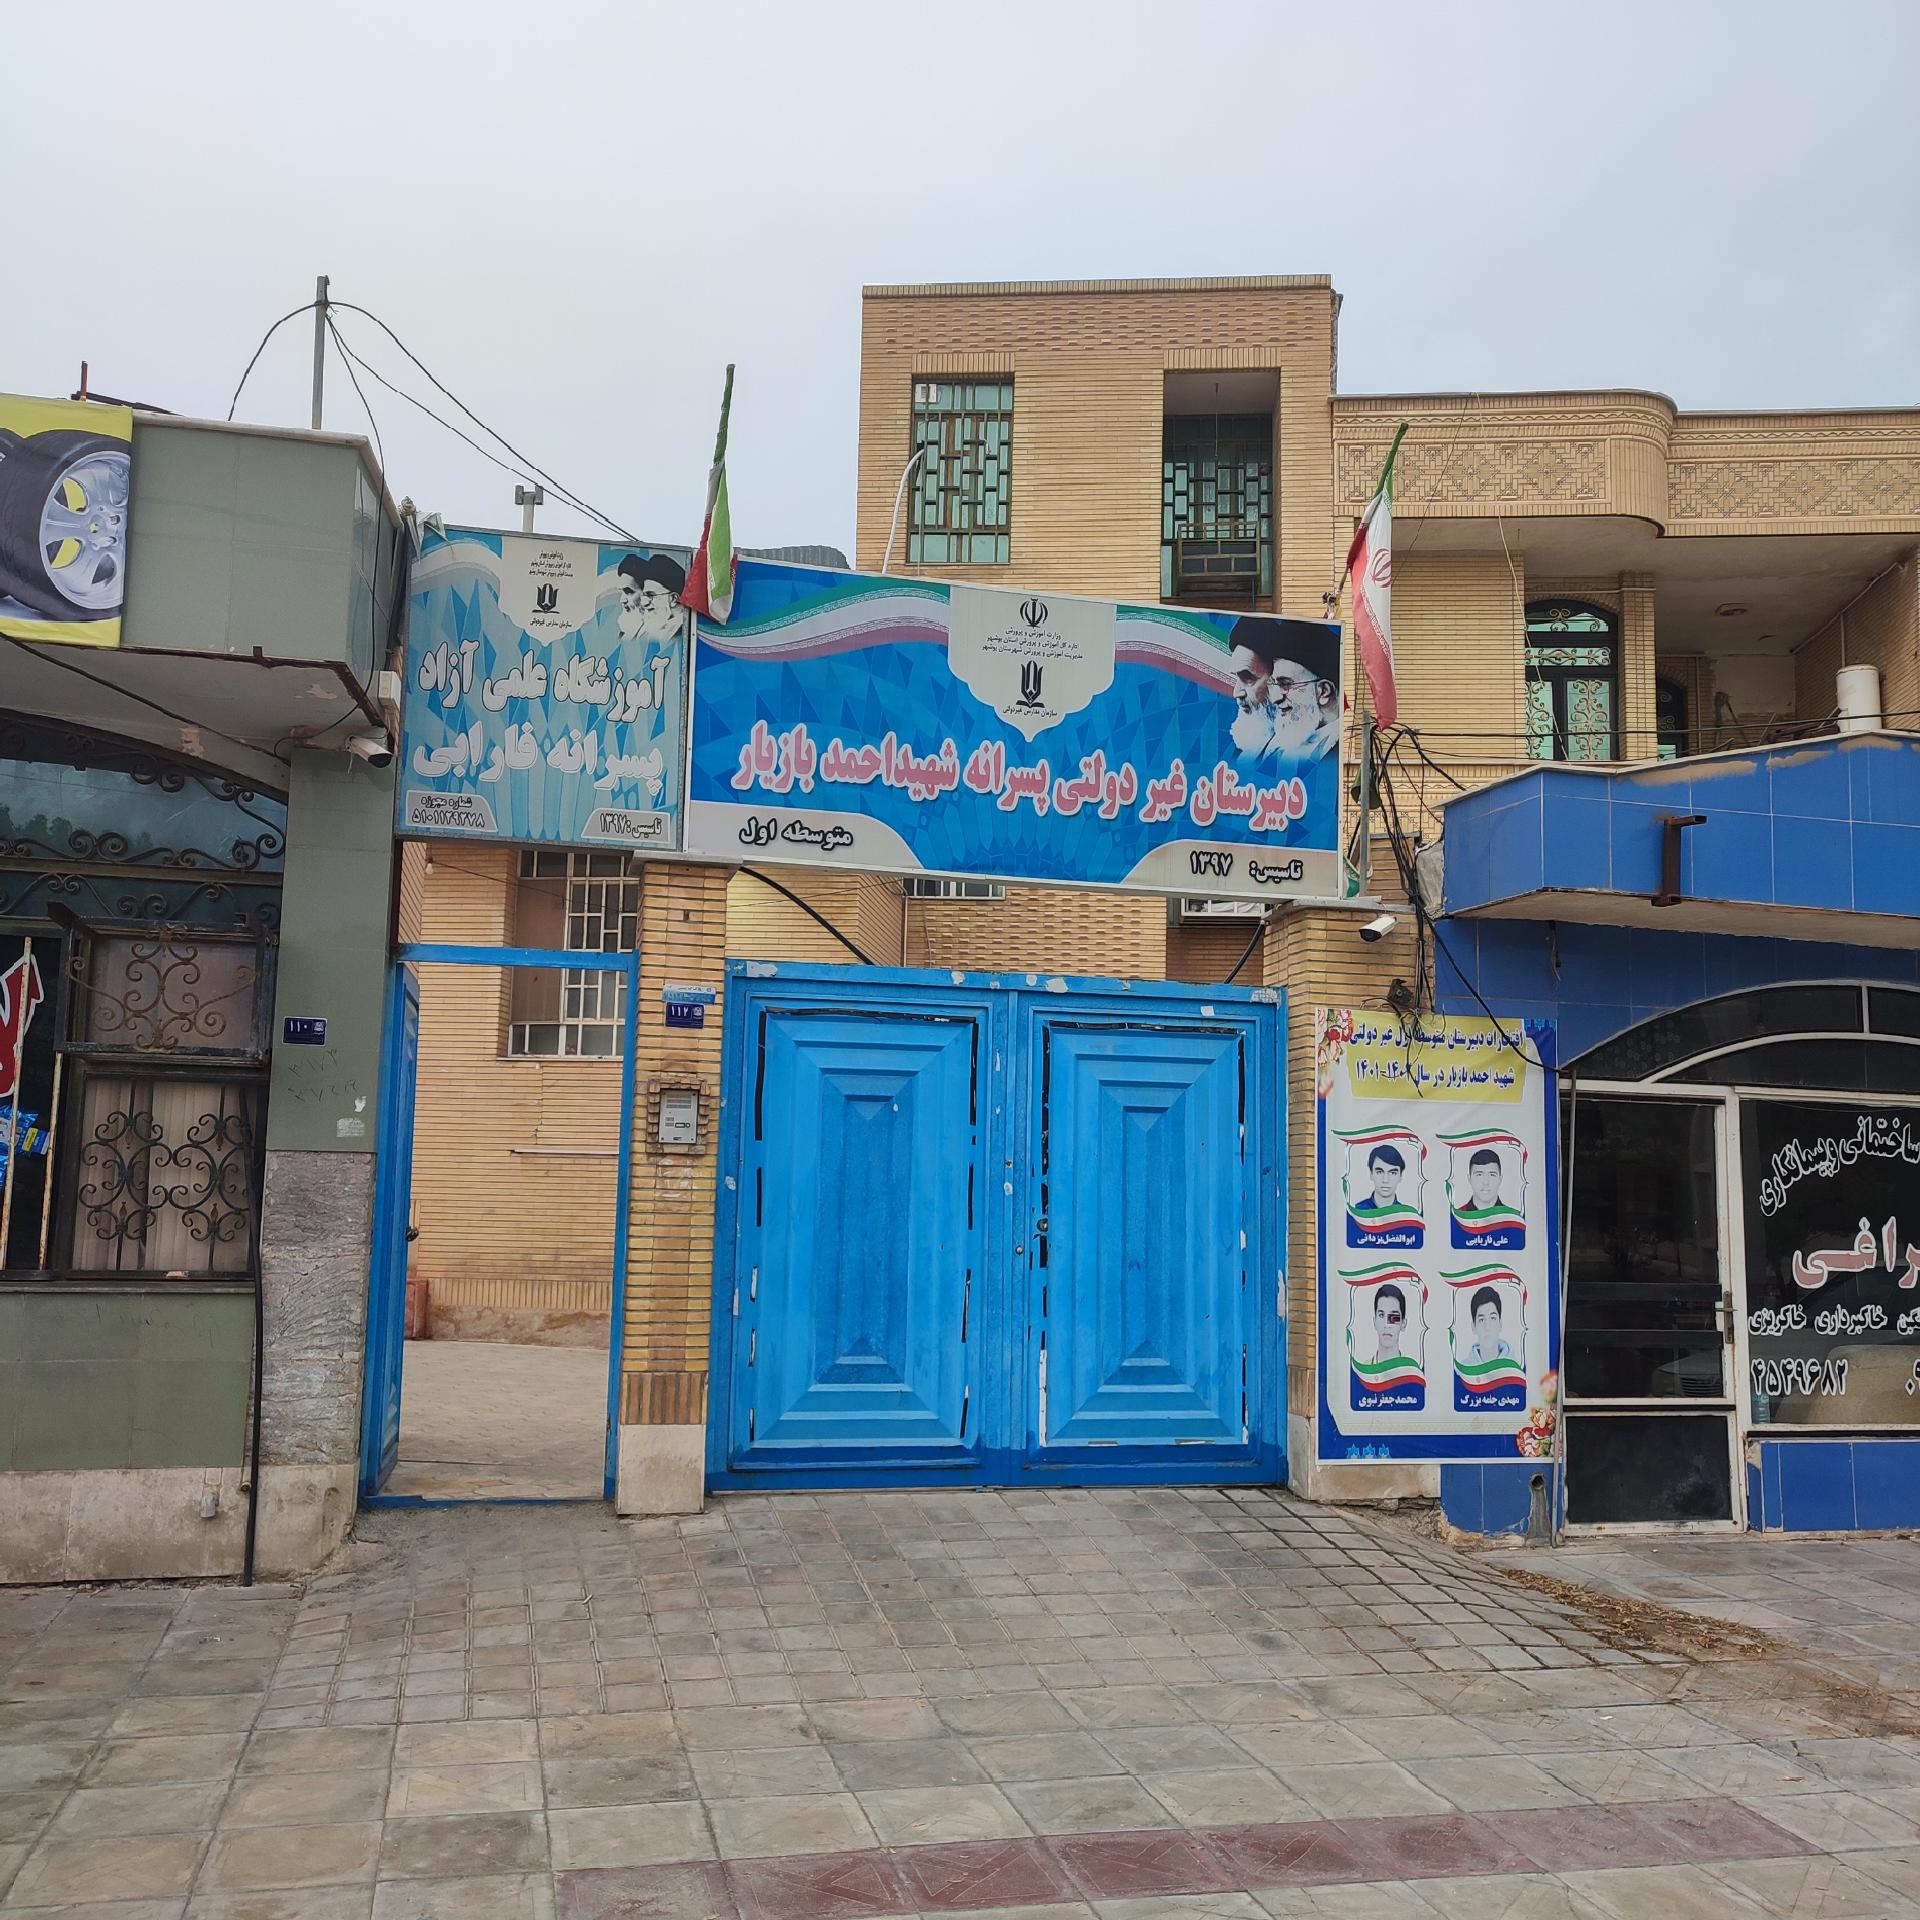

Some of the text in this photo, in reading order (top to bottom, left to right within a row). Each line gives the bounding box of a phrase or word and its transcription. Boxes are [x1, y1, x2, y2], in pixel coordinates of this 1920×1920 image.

[418, 639, 670, 723] آموزشگاه علمی آزاد
[1041, 708, 1058, 718] سازمان
[413, 720, 663, 796] پسرانه فارابی
[731, 719, 817, 793] بازیار
[963, 740, 1050, 816] پسرانه
[1053, 749, 1138, 819] دولتی
[1139, 758, 1187, 822] غیر
[449, 796, 473, 810] شماره
[1190, 760, 1308, 831] دبیرستان
[739, 816, 853, 850] متوسطه اول
[1190, 851, 1233, 876] ۱۳۹۷
[671, 1005, 689, 1017] ۱۱۲
[290, 1020, 308, 1033] ۱۱۰
[1350, 1023, 1378, 1046] دولتی
[1379, 1026, 1393, 1047] غیر
[1414, 1024, 1446, 1049] متوسطه
[1447, 1027, 1484, 1051] دبیرستان
[1414, 1063, 1430, 1087] سال
[1433, 1068, 1446, 1087] در
[1469, 1069, 1492, 1084] احمد
[1493, 1067, 1516, 1089] شهید
[1493, 1235, 1508, 1246] علی
[1792, 1215, 1920, 1289] راغی
[1748, 1304, 1807, 1336] خاکریزی
[1815, 1304, 1888, 1335] خاکبرداری
[1751, 1358, 1848, 1396] ۴۵۴۹۶۸۲
[1358, 1393, 1418, 1407] محمد جعفر نبوی
[1498, 1396, 1520, 1407] مهدی
